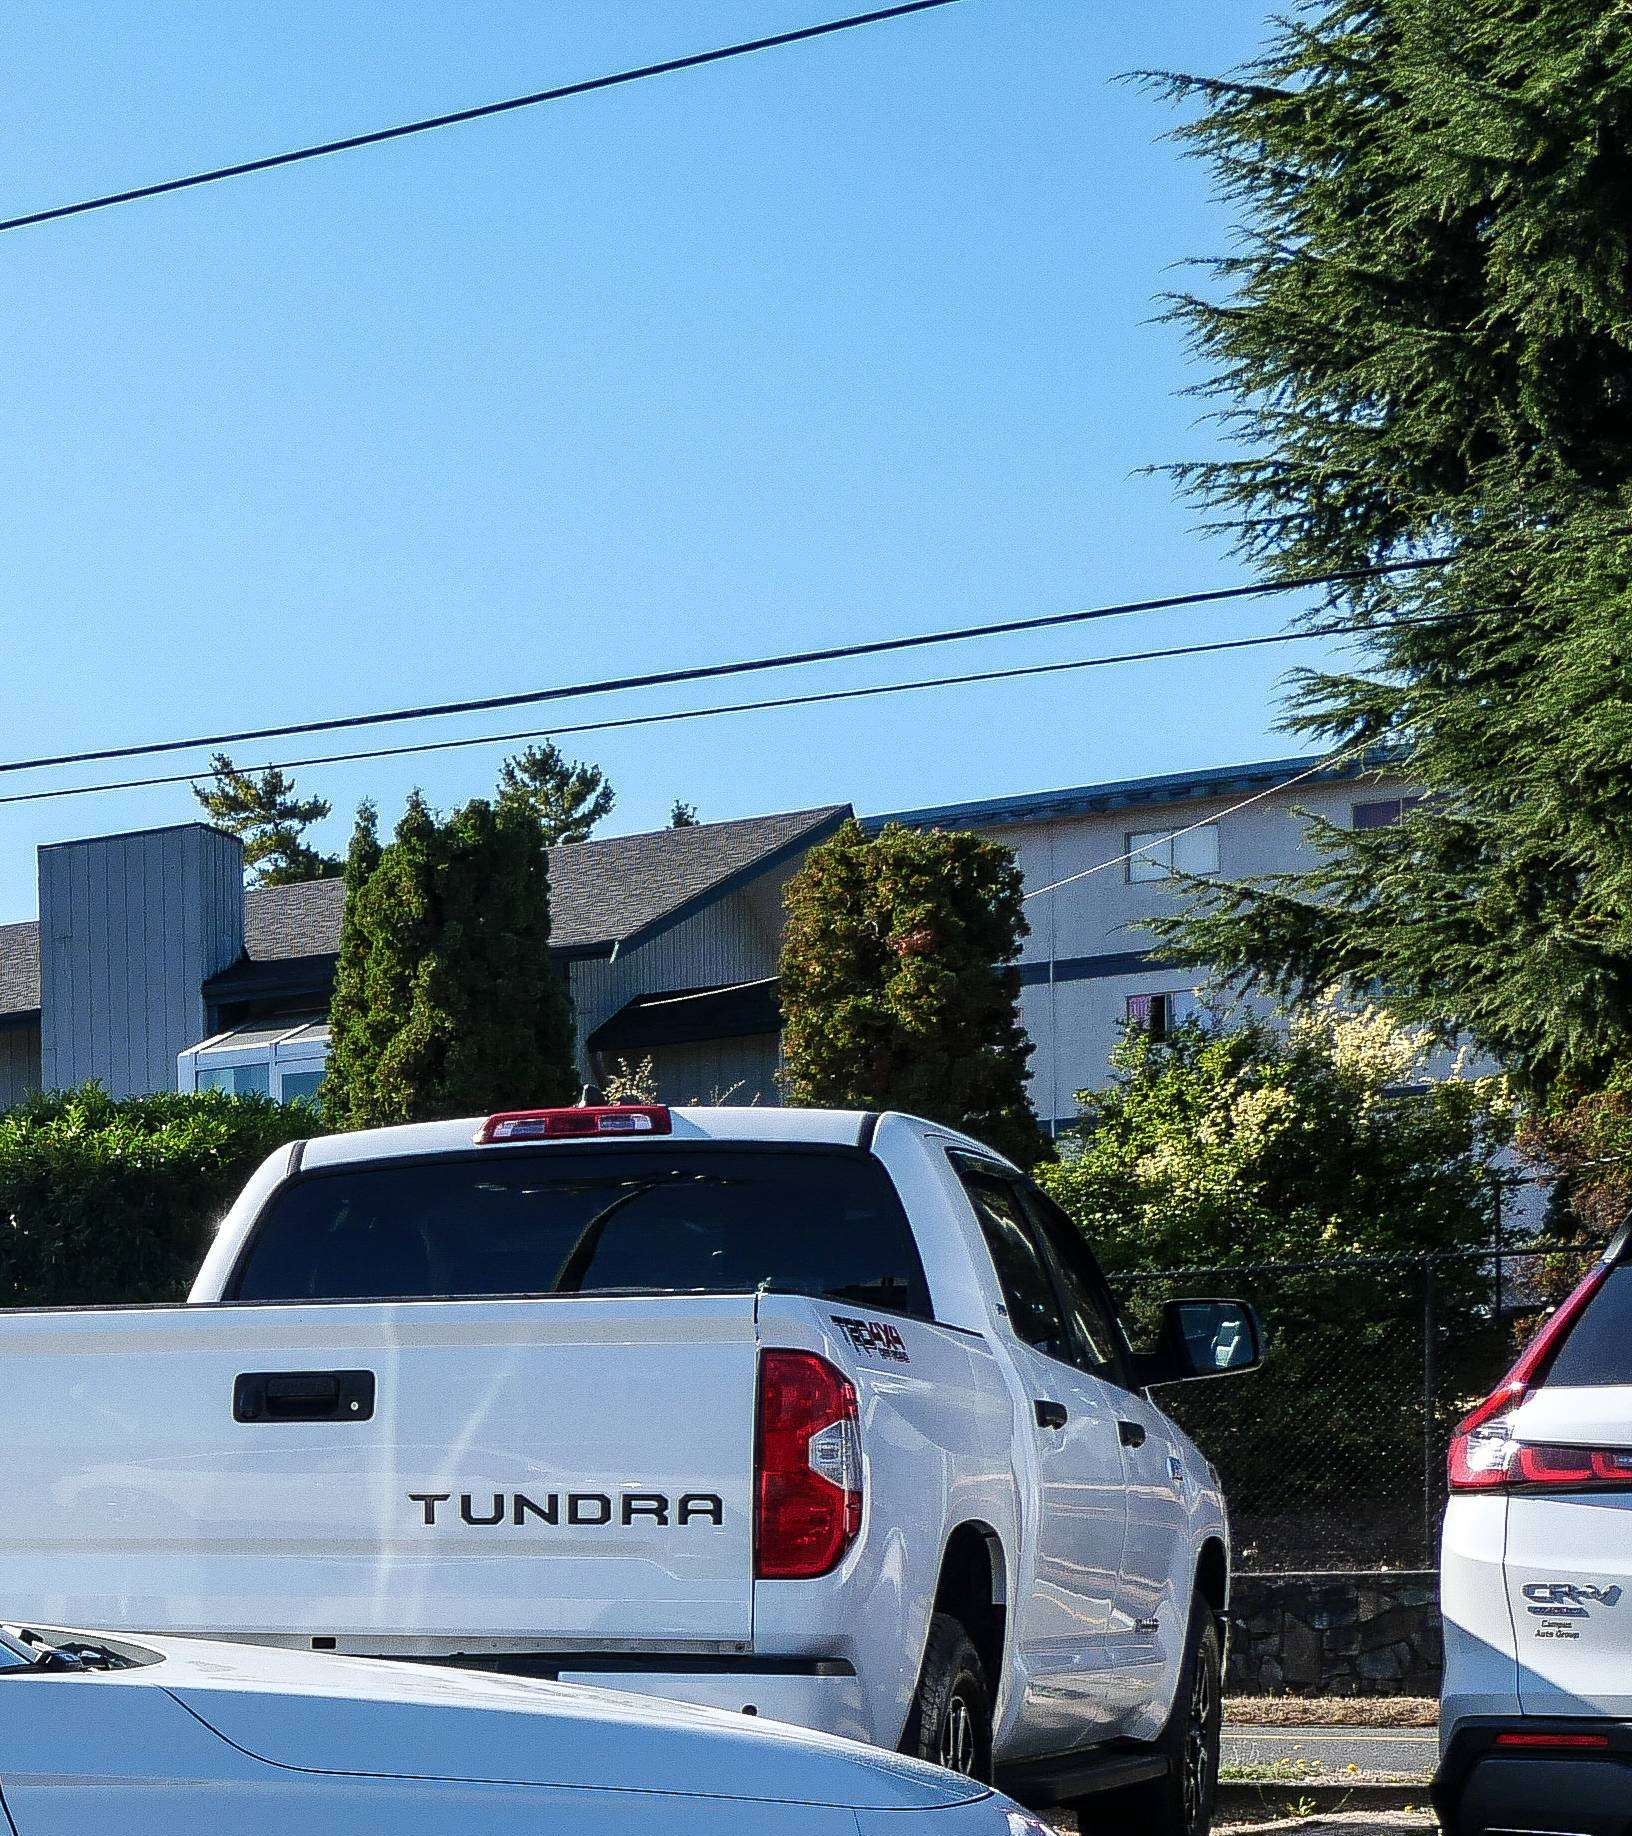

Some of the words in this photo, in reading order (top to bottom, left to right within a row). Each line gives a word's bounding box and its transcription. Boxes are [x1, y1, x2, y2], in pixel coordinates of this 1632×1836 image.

[407, 1493, 724, 1527] TUNDRA
[1541, 1619, 1573, 1630] Campus
[1535, 1630, 1554, 1639] Auto
